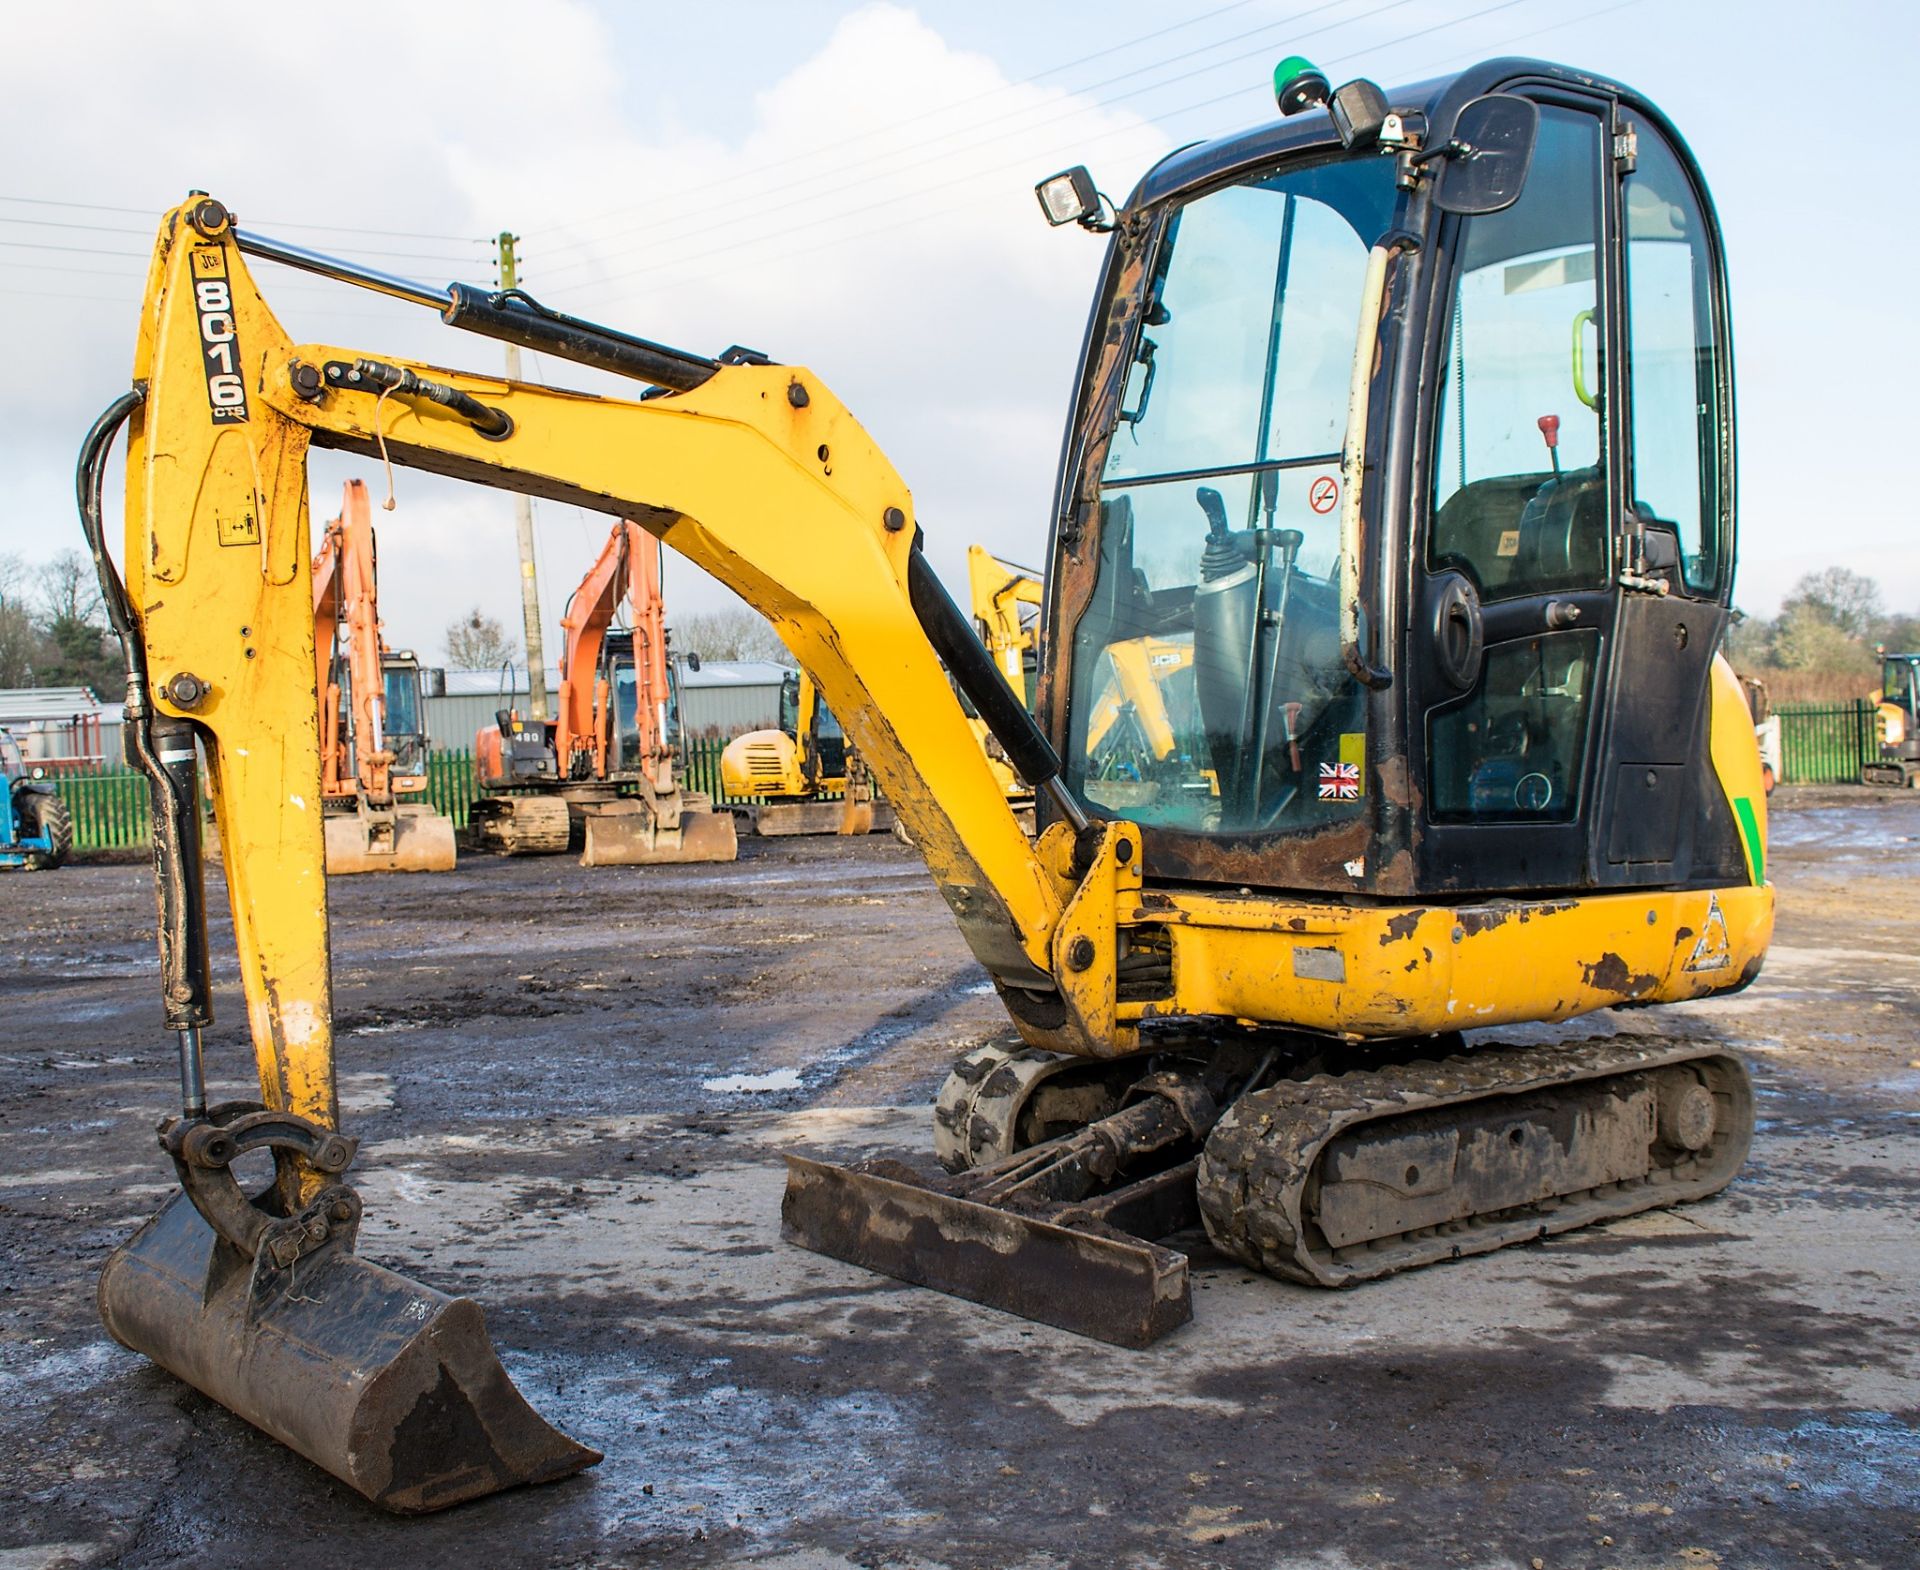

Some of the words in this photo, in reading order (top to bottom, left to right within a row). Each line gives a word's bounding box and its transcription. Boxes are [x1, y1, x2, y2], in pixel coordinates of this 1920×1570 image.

[201, 254, 219, 269] JCB
[196, 281, 244, 406] 8016
[214, 406, 245, 417] CTS
